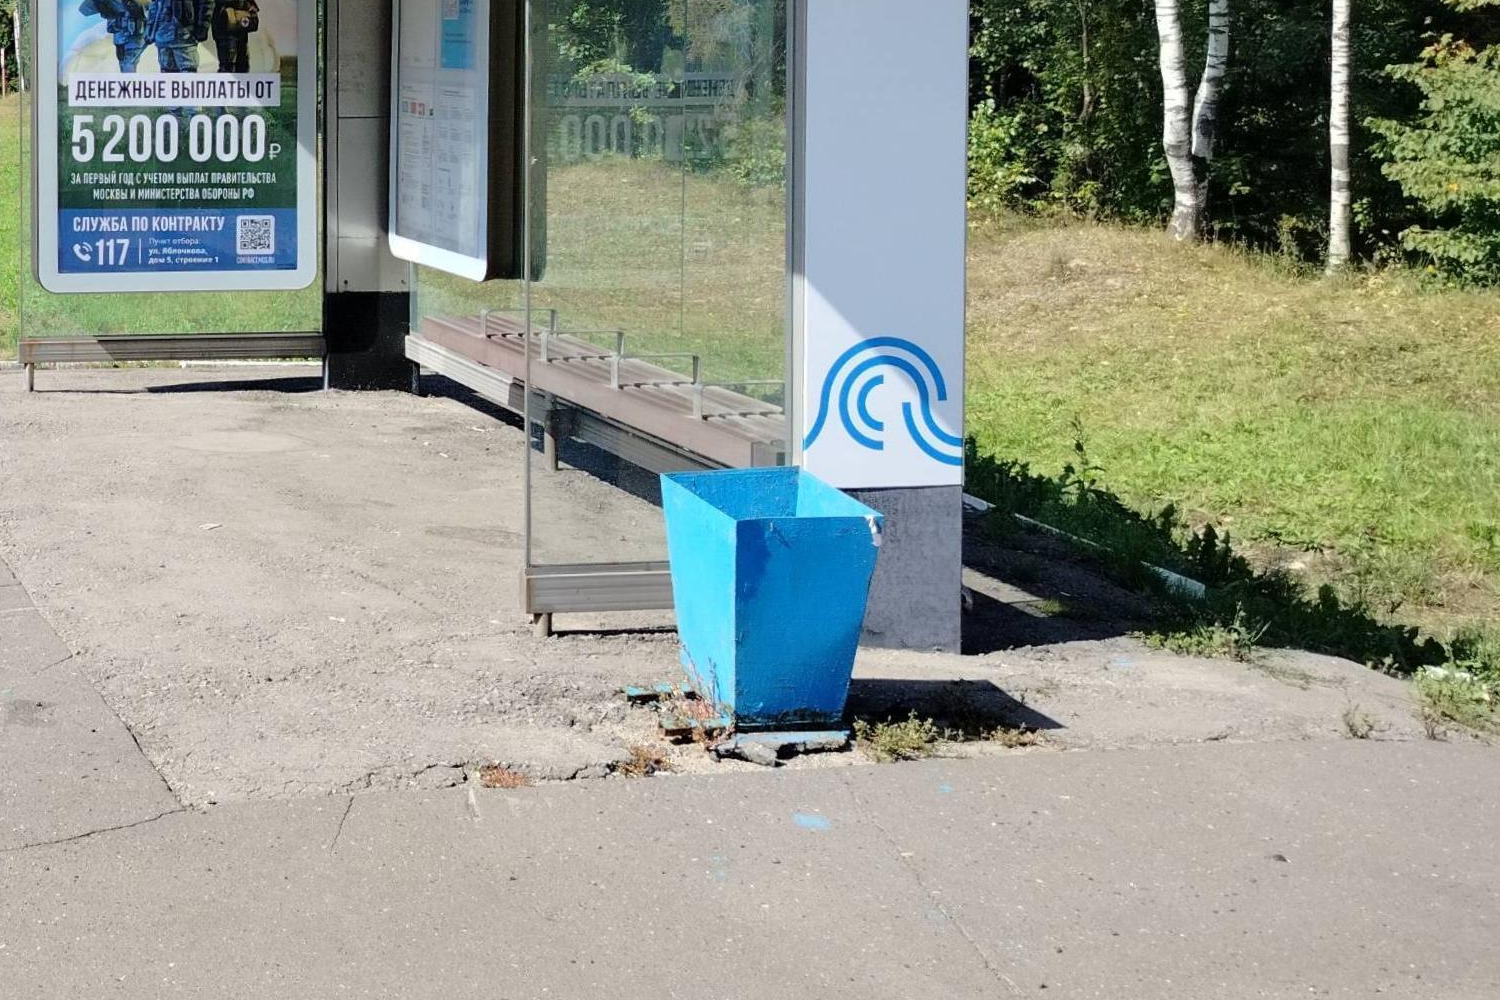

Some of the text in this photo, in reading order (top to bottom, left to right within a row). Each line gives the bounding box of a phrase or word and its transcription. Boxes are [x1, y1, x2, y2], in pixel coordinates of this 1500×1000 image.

[75, 80, 274, 100] ДЕНЕЖНЫЕ ВЫПЛАТЫ ОТ
[71, 114, 95, 162] 5
[102, 114, 179, 162] 200
[189, 114, 266, 162] 000
[70, 170, 277, 186] ЗА ПЕРВЫЙ ГОД С УЧЕТОМ ВЫПЛАТ ПРАВИТЕЛЬСТВА
[93, 187, 255, 200] МОСКВЫ И МИНИСТЕРСТВА ОБОРОНЫ РФ
[73, 215, 225, 232] СЛУЖБА ПО КОНТРАКТУ
[148, 238, 171, 246] Пункт
[95, 238, 130, 265] 117
[148, 248, 160, 256] ул.
[148, 257, 165, 265] дом
